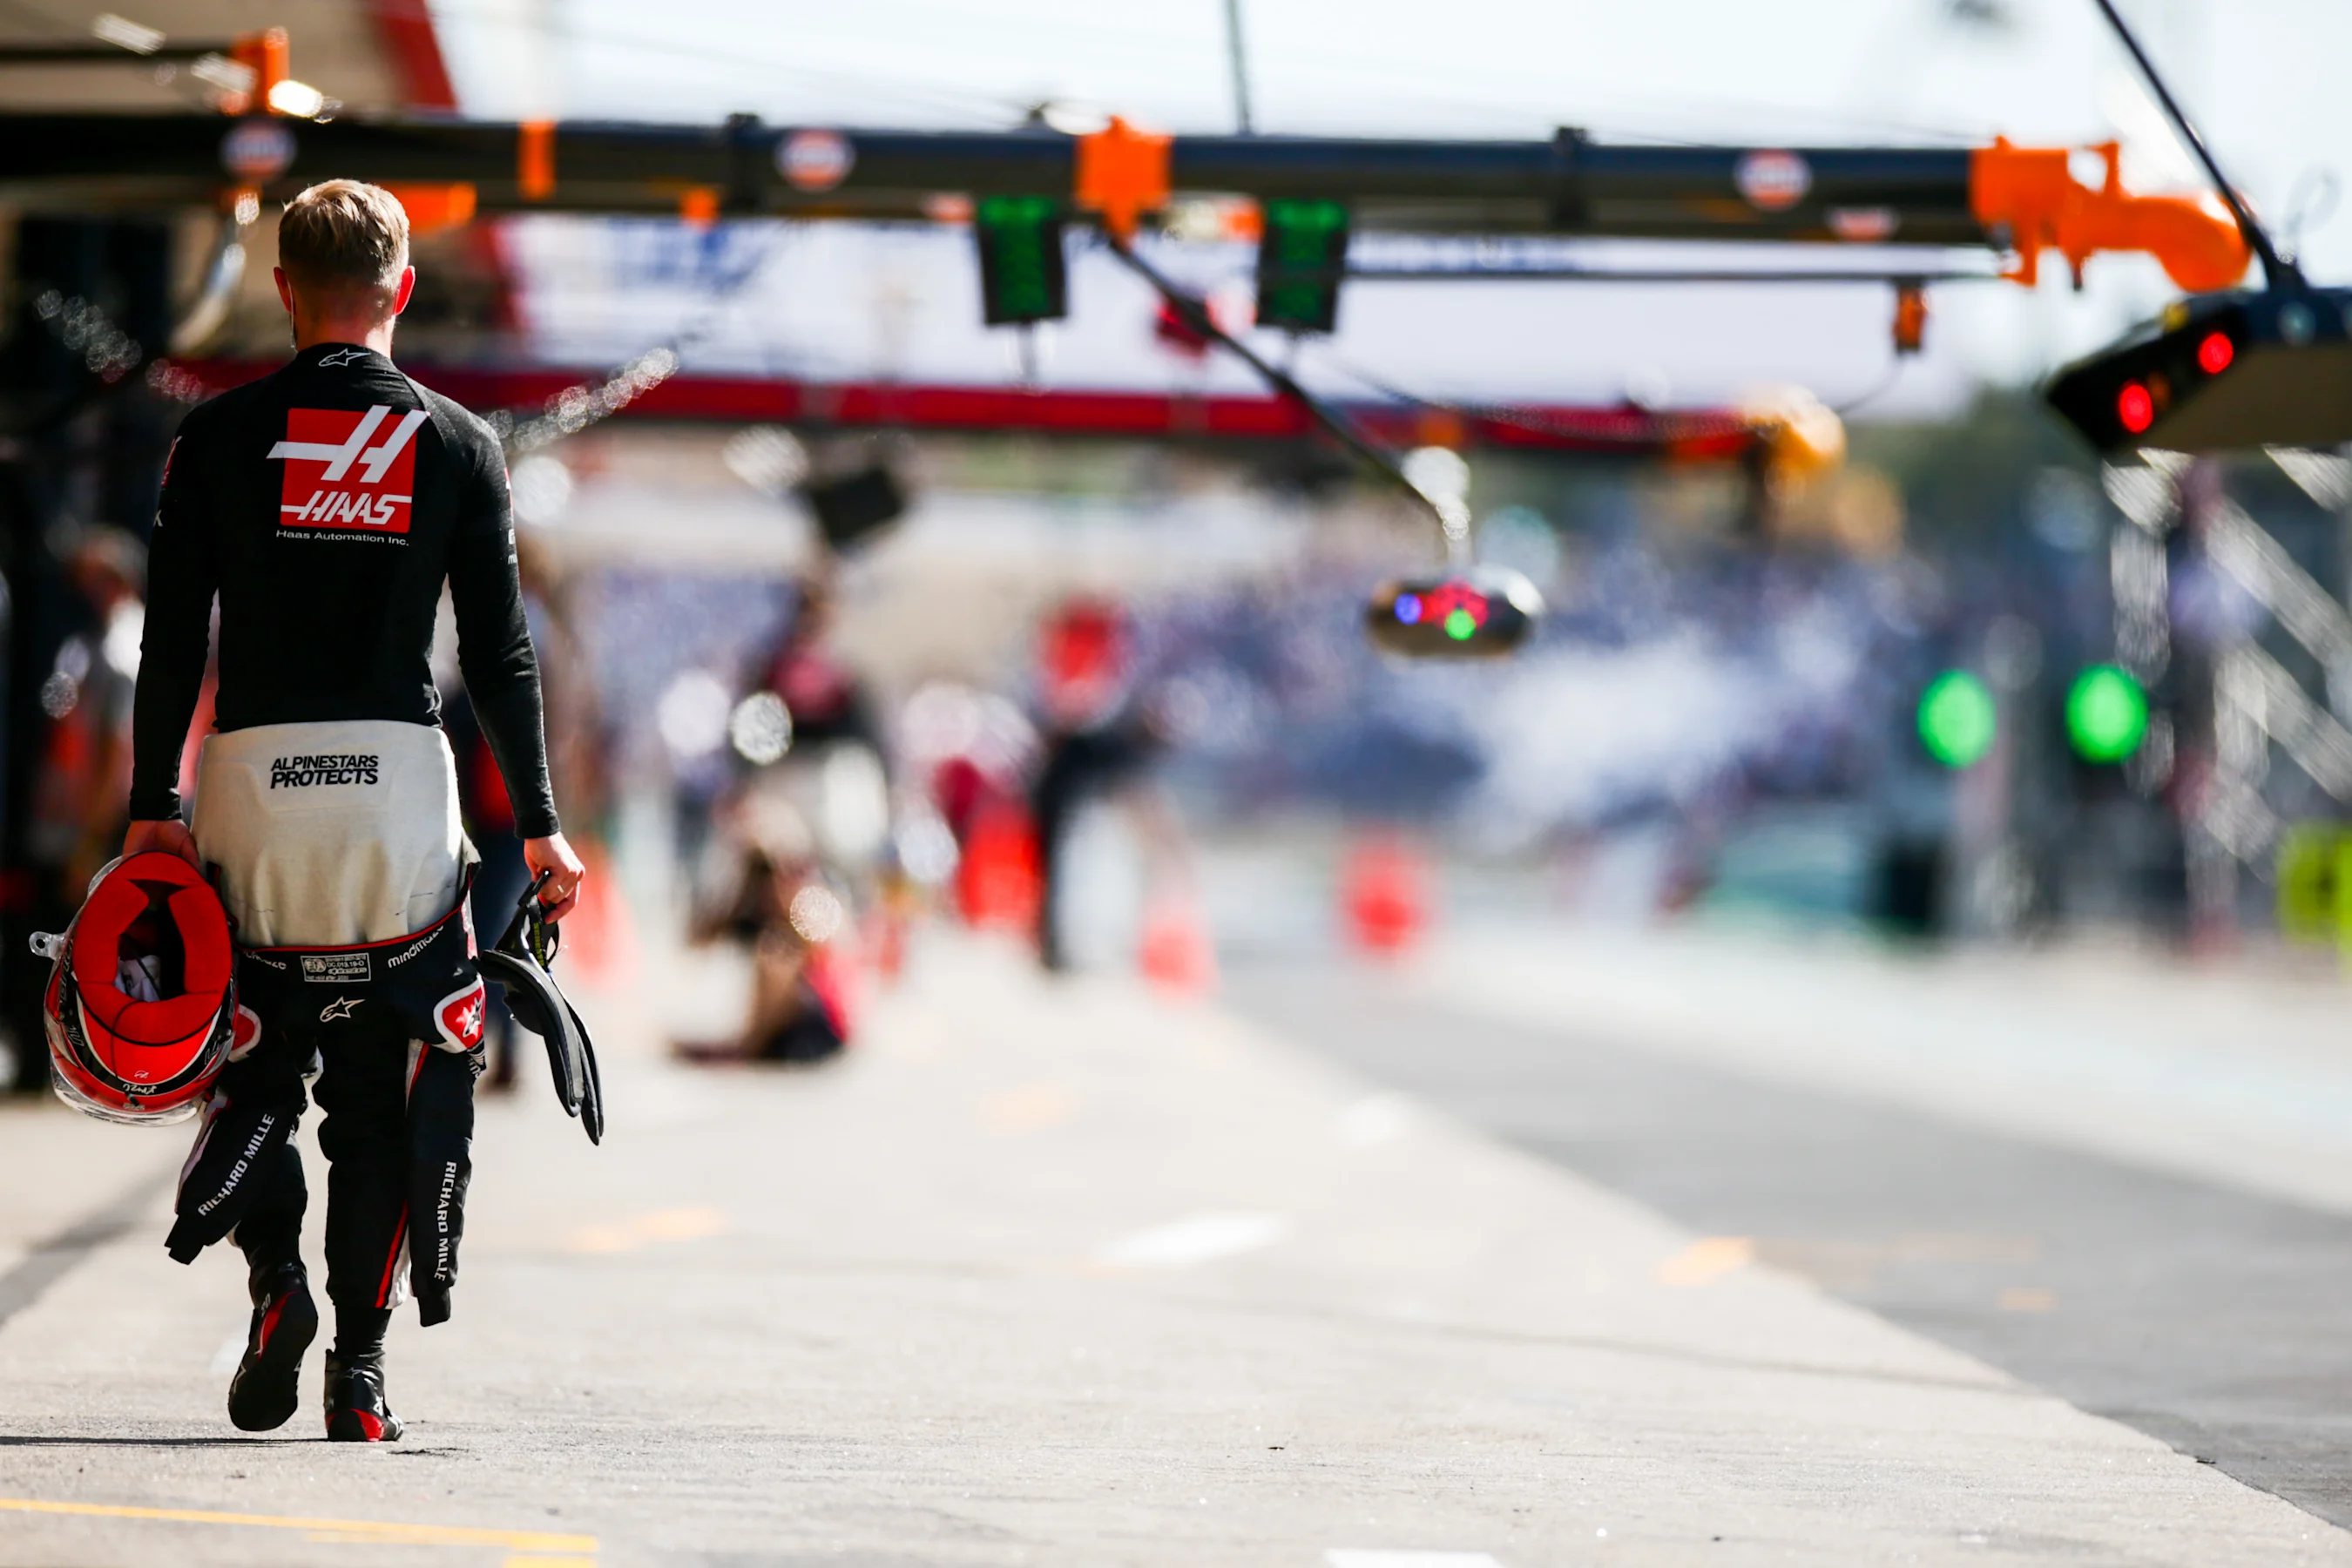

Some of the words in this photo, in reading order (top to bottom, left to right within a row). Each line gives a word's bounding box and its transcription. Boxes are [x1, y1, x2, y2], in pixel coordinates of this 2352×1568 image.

[280, 490, 412, 525] HAAS
[276, 530, 310, 539] Haas
[314, 531, 385, 544] Automation
[389, 537, 409, 546] Inc.
[270, 768, 378, 789] PROTECTS
[271, 754, 379, 772] ALPINESTARS
[198, 1159, 248, 1216] RICHARD
[244, 1114, 274, 1159] MILLE
[436, 1161, 457, 1233] RICHARD
[434, 1238, 449, 1281] MILLE
